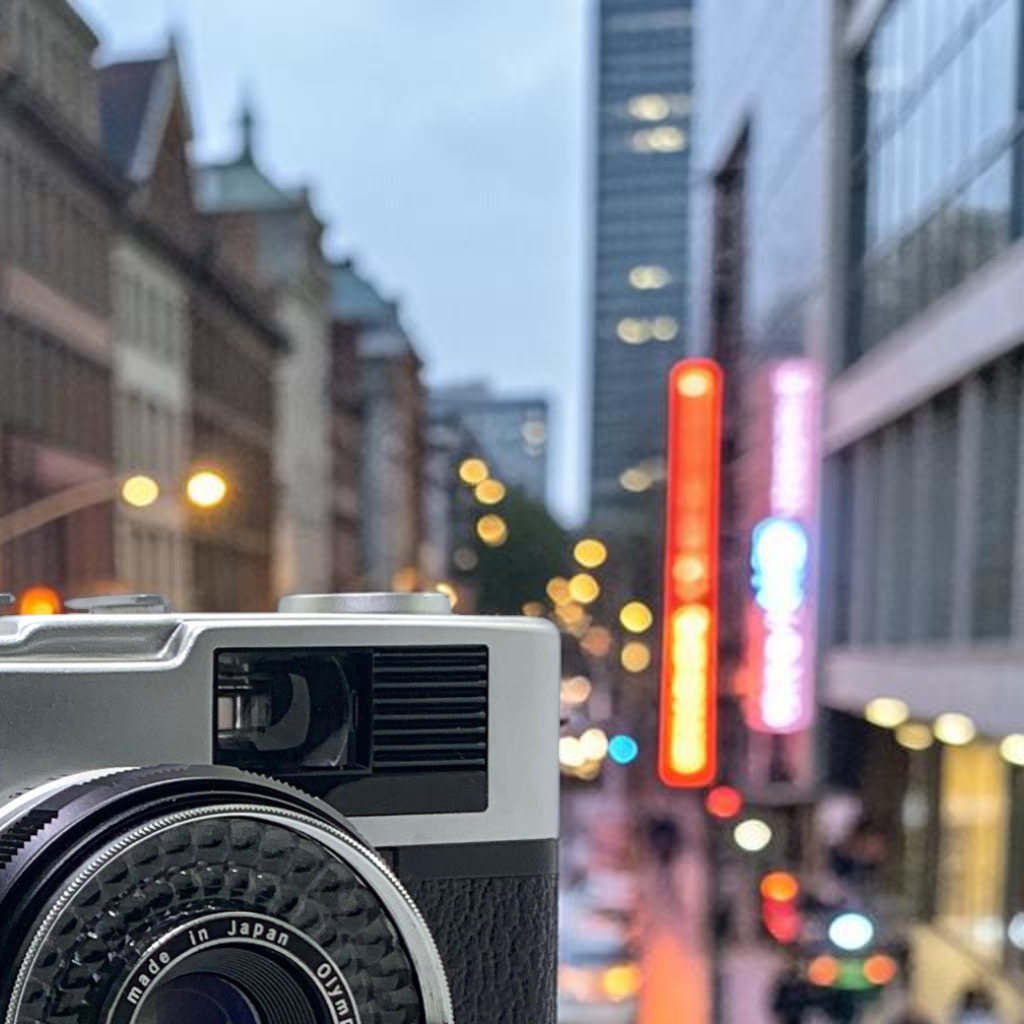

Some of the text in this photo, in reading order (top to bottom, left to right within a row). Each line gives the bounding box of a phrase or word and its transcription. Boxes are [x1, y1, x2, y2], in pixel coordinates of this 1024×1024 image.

[127, 951, 171, 1005] made
[189, 926, 209, 946] in
[227, 919, 289, 946] Japan
